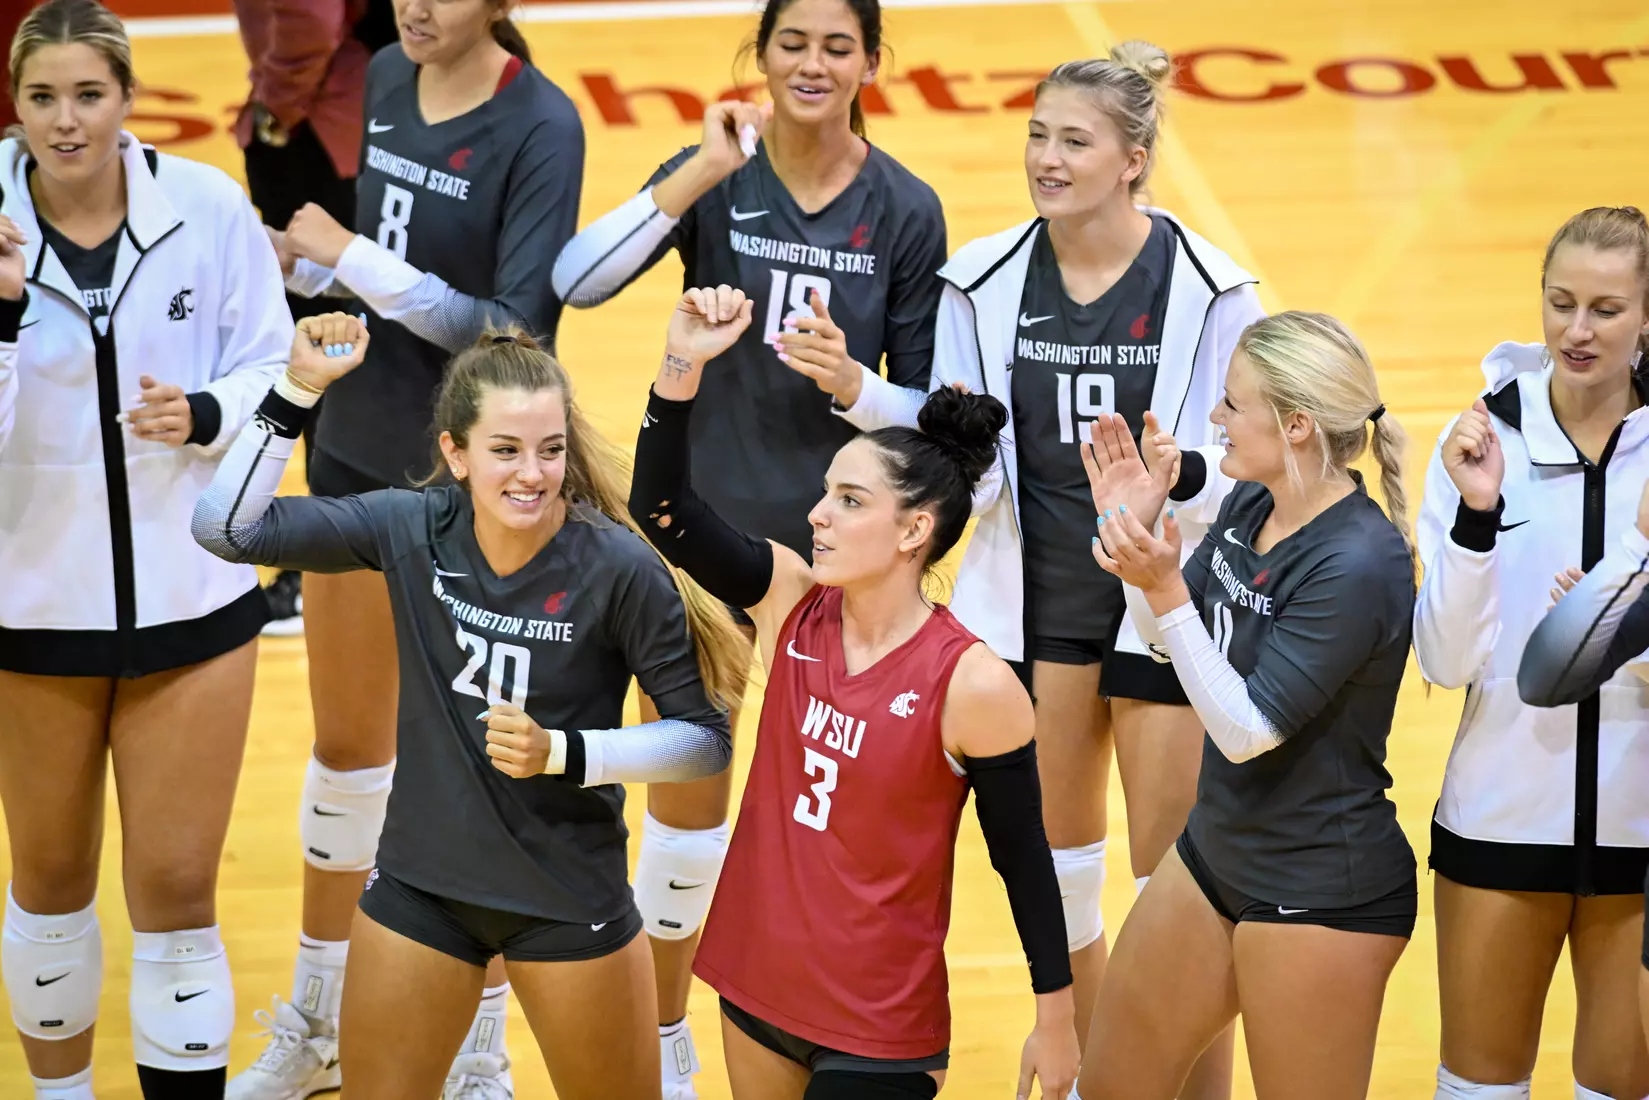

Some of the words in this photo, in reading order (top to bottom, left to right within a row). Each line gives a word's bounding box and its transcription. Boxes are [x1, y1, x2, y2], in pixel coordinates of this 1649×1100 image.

[1171, 46, 1649, 102] Cour
[425, 168, 471, 200] STATE
[377, 182, 414, 261] 8
[729, 229, 831, 269] WASHINGTON
[833, 251, 876, 275] STATE
[763, 268, 831, 345] 18
[664, 364, 688, 382] IT
[666, 354, 693, 371] FUCK
[1018, 337, 1112, 365] WASHINGTON
[1117, 344, 1160, 365] STATE
[1055, 373, 1116, 444] 19
[1211, 546, 1246, 603] WASHING
[523, 619, 574, 643] STATE
[1213, 601, 1234, 660] 11
[452, 620, 532, 712] 20
[800, 695, 867, 759] WSU
[793, 746, 839, 832] 3
